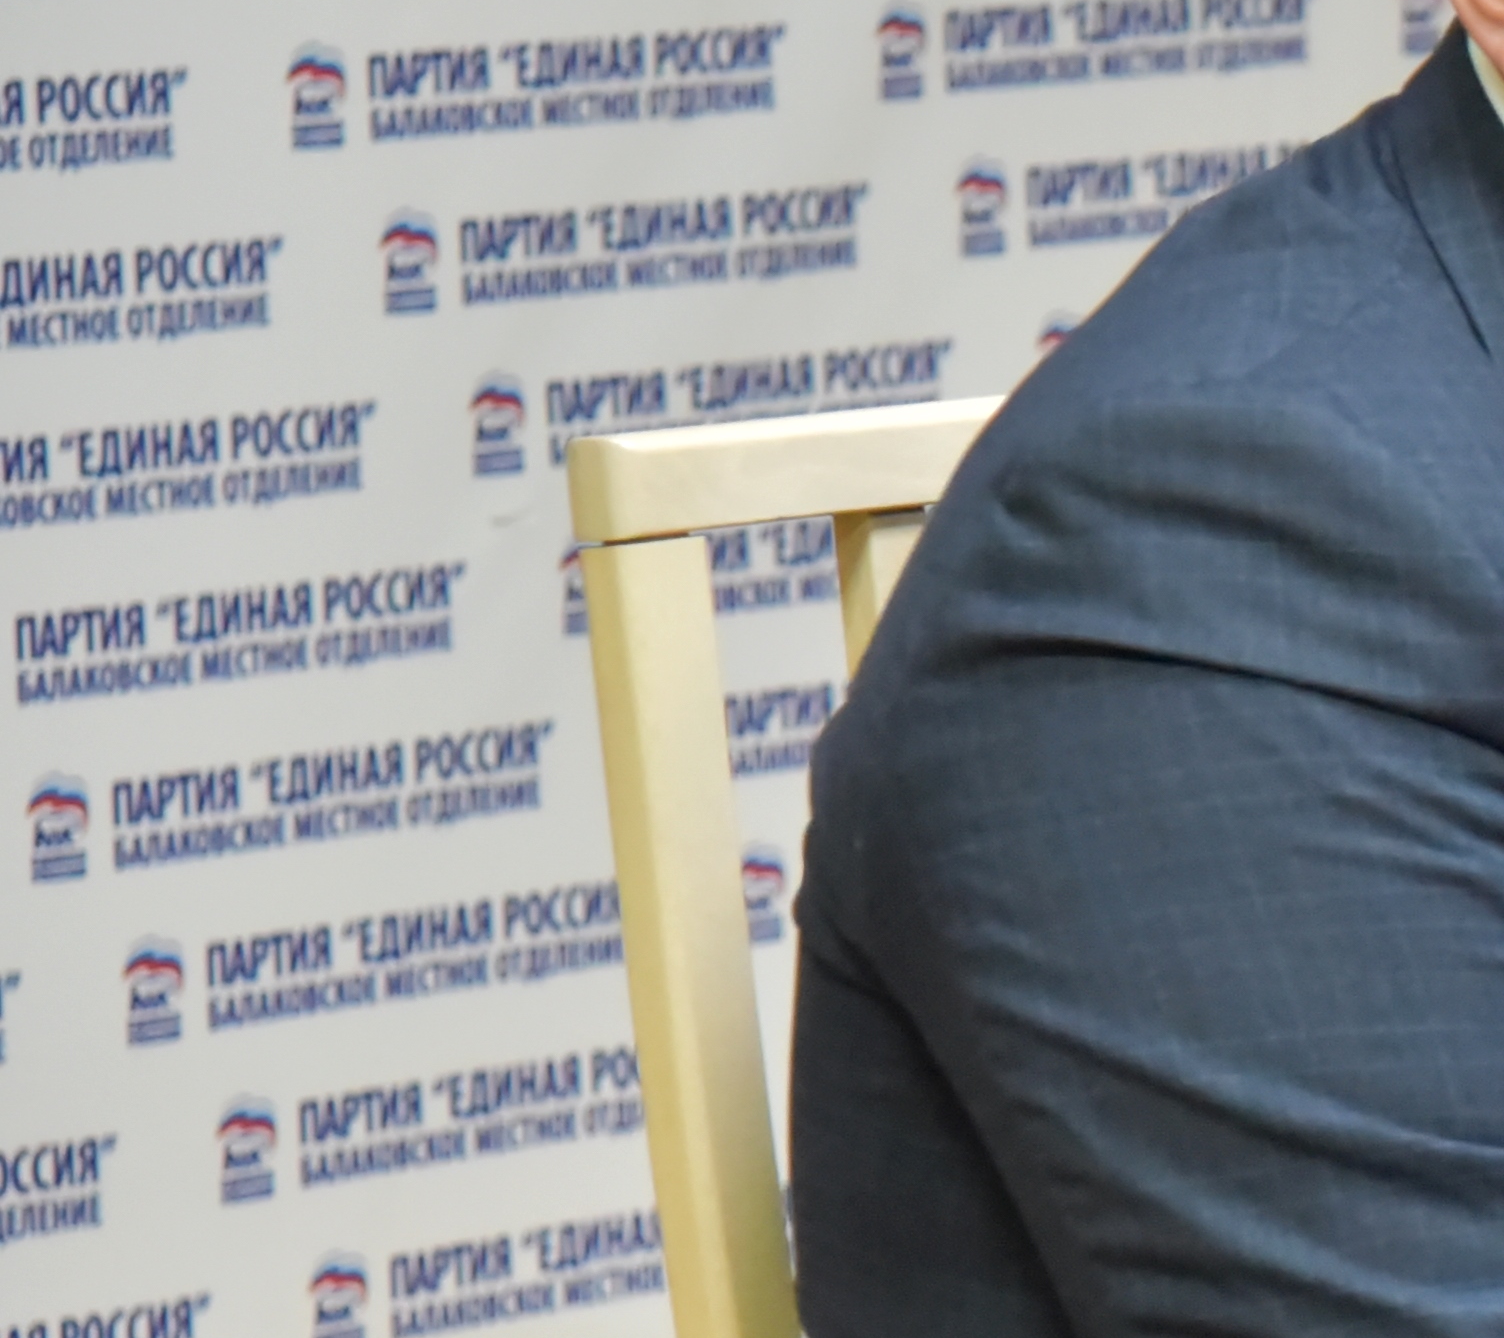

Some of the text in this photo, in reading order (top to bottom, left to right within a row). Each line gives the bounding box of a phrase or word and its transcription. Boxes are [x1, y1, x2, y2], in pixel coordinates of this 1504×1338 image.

[368, 46, 491, 100] ПАРТИЯ
[29, 122, 174, 175] ОТДЕЛЕНИЕ
[460, 210, 578, 264] ПАРТИЯ
[0, 248, 126, 311] ДИНАЯ
[6, 291, 271, 351] МЕСТНОЕ ОТДЕЛЕНИЕ
[546, 370, 668, 426] ПАРТИЯ
[106, 473, 215, 516] МЕСТНОЕ
[224, 457, 361, 505] ОТДЕЛЕНИЕ
[15, 602, 147, 662] ПАРТИЯ
[17, 618, 452, 705] БАЛАКОВСКОЕ МЕСТНОЕ ОТДЕЛЕНИЕ
[112, 766, 241, 827] ПАРТИЯ
[114, 777, 540, 870] БАЛАКОВСКОЕ МЕСТНОЕ ОТДЕЛЕНИЕ
[207, 925, 333, 988] ПАРТИЯ
[503, 877, 621, 938] РОССИЯ
[208, 973, 377, 1031] БАЛАКОВСКОЕ
[385, 955, 488, 1001] МЕСТНОЕ
[299, 1081, 424, 1145] ПАРТИЯ
[0, 1132, 117, 1196] ССИЯ”
[390, 1236, 513, 1299] ПАРТИЯ
